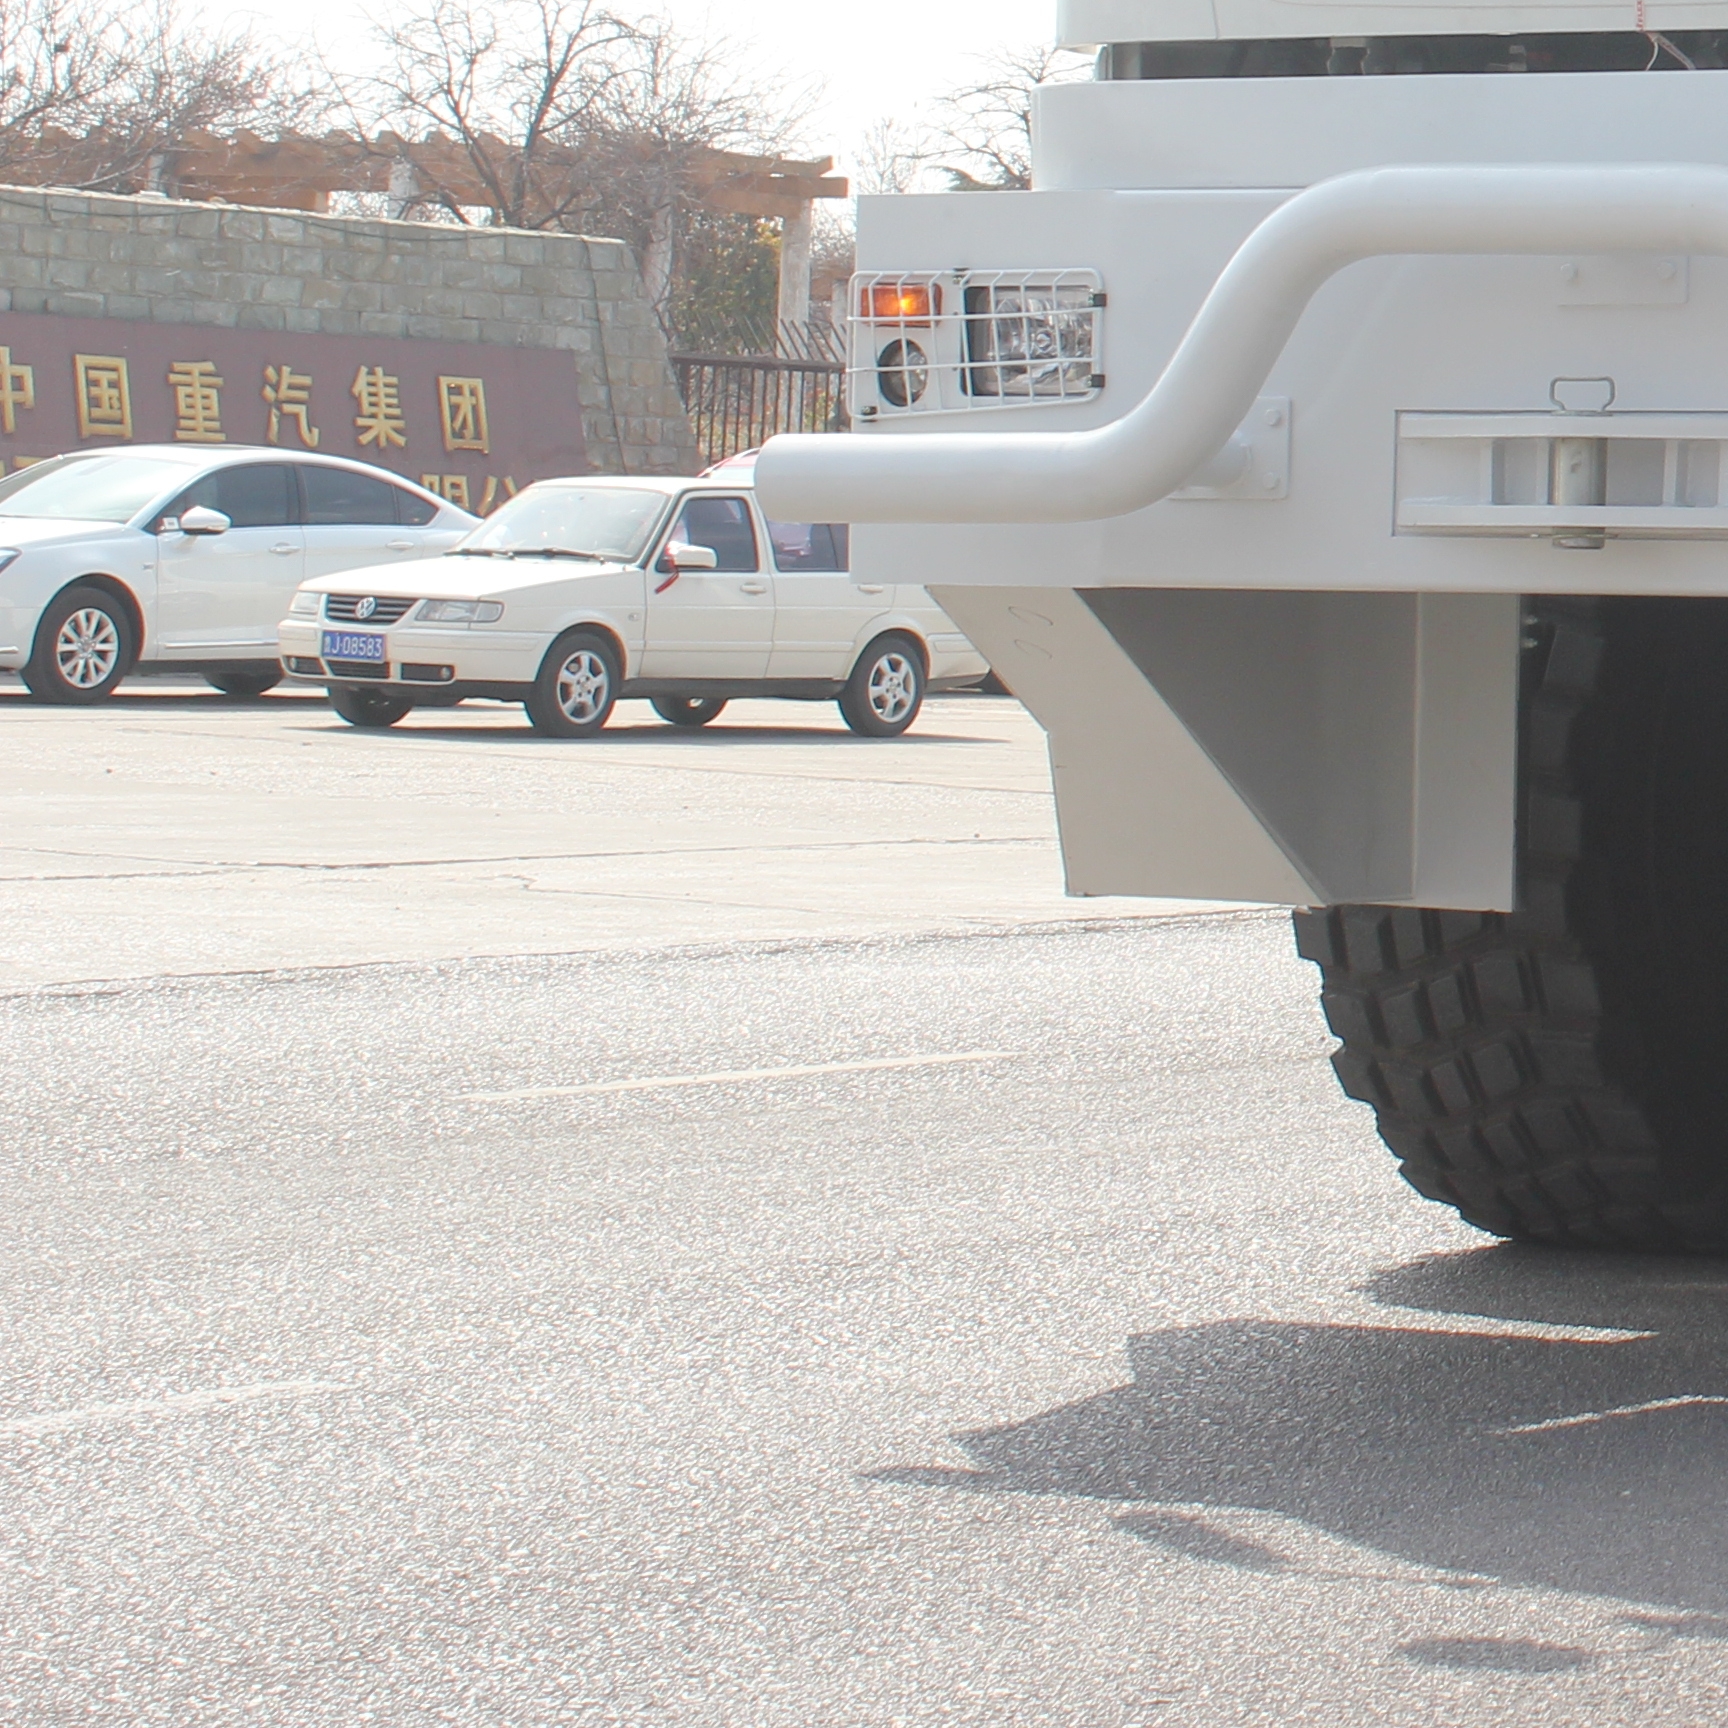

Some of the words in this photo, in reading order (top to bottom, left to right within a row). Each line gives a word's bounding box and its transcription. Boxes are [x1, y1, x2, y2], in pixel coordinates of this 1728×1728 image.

[0, 345, 490, 454] 中国重汽集团
